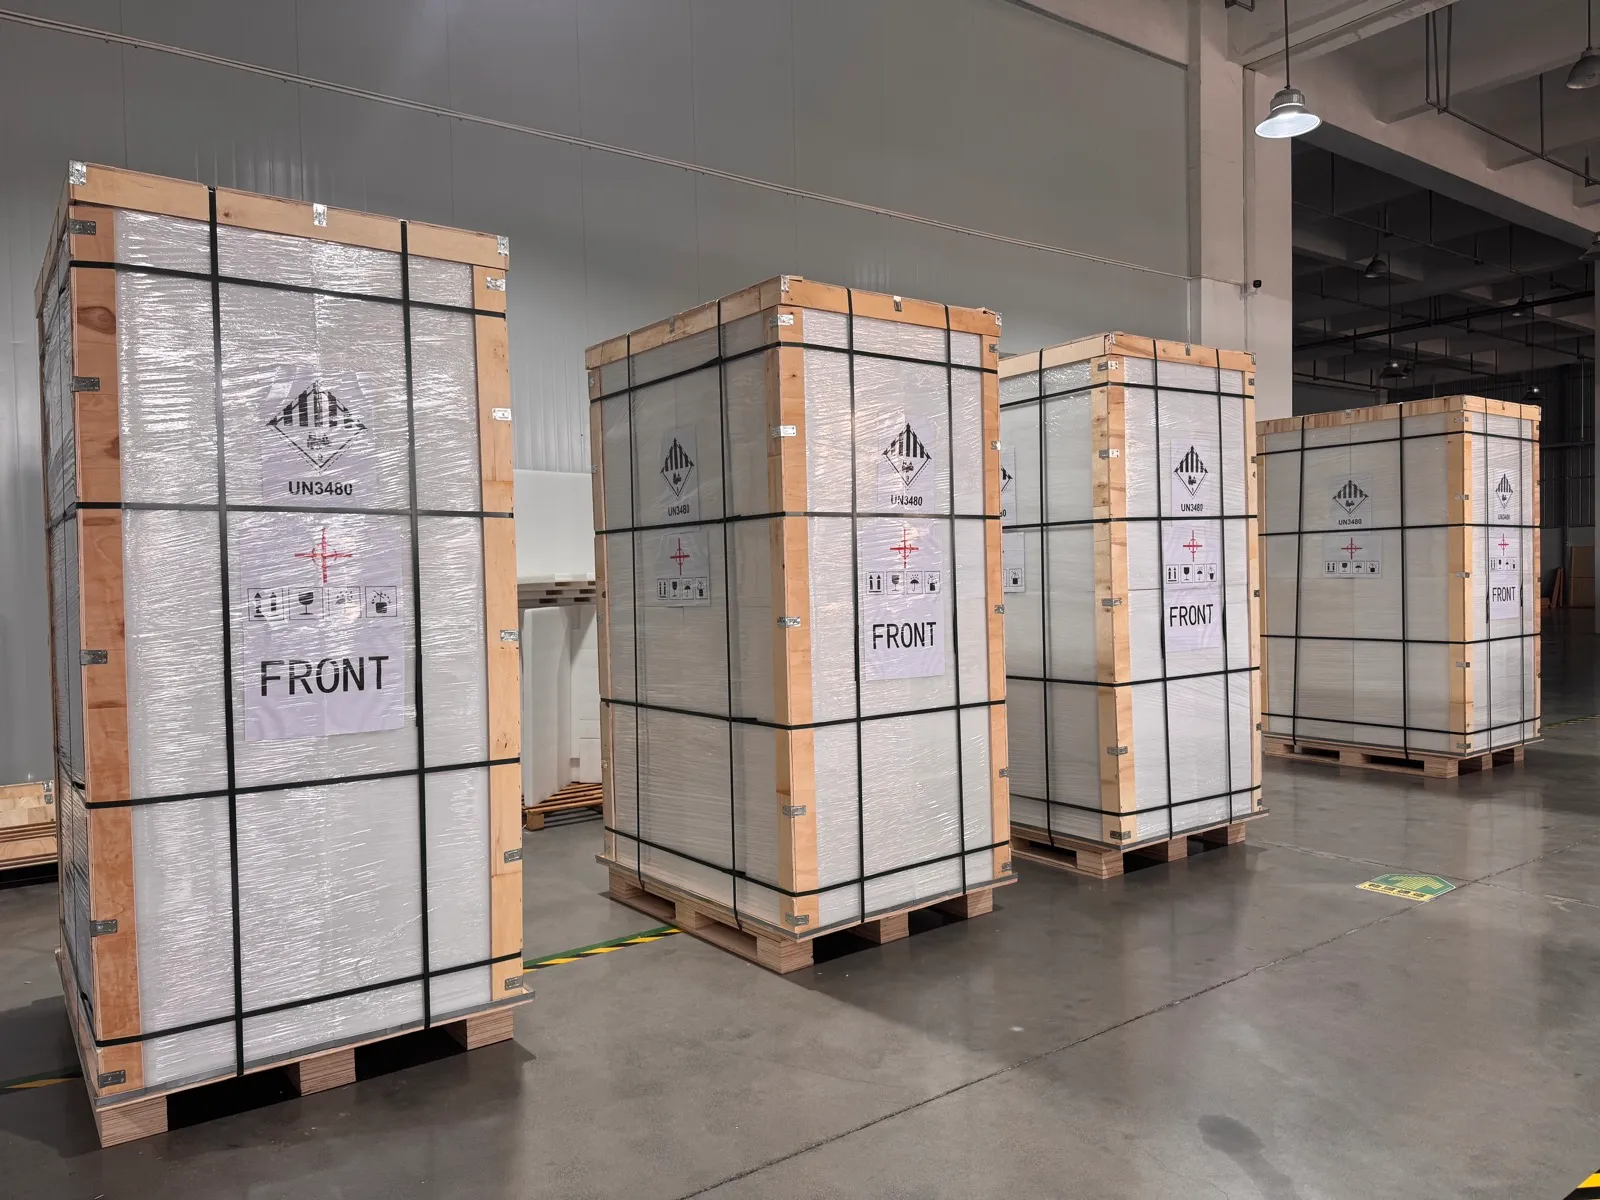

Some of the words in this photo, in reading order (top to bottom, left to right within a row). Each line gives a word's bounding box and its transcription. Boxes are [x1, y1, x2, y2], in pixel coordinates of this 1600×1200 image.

[288, 481, 353, 496] UN3480
[891, 494, 923, 506] UN3480
[1180, 503, 1204, 512] UN3480
[667, 503, 690, 517] UN3480
[1338, 518, 1363, 526] UN3480
[1492, 586, 1516, 602] FRONT
[1169, 603, 1214, 627] FRONT
[872, 621, 937, 650] FRONT
[260, 655, 389, 697] FRONT
